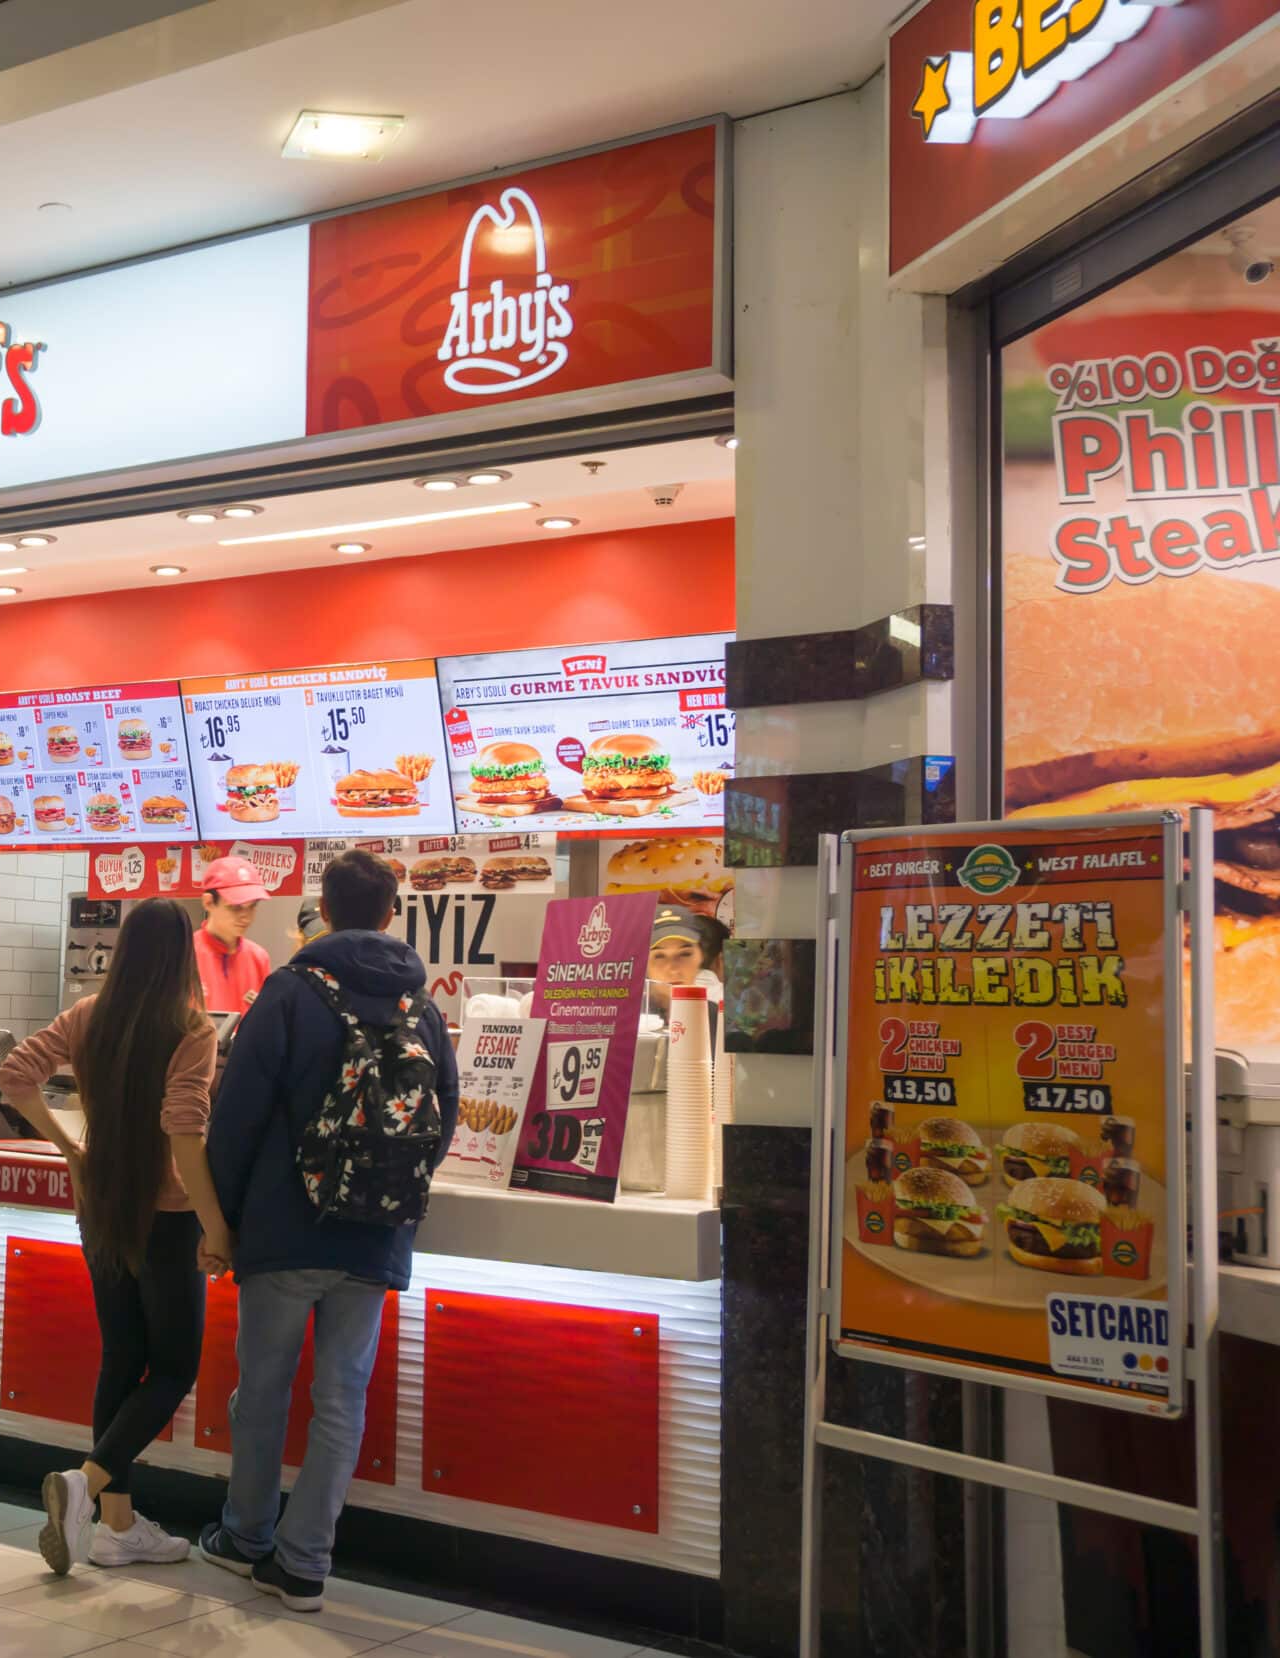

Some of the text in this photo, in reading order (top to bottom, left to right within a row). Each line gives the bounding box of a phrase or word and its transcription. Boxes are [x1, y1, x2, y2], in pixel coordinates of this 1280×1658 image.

[437, 272, 573, 362] Arby's
[1050, 355, 1181, 411] %100
[566, 657, 603, 673] YENİ
[270, 673, 327, 687] CHICKEN
[455, 685, 482, 700] ARBY'S
[510, 680, 575, 697] GURME
[578, 674, 640, 692] TAVUK
[56, 689, 122, 703] ROAST BEEF
[870, 860, 940, 878] BEST BURGER
[1038, 850, 1147, 873] WEST FALAFEL
[880, 901, 1116, 952] LEZZETİ
[547, 957, 634, 982] SİNEMA KEYFİ
[874, 954, 1128, 1008] İKİLEDİK
[550, 1002, 618, 1017] Cinemaximum
[481, 1024, 523, 1034] YANINDA
[908, 1021, 940, 1038] BEST
[1057, 1025, 1096, 1042] BEST
[475, 1035, 521, 1057] EFSANE
[879, 1017, 908, 1073] 2
[908, 1038, 962, 1057] CHICKEN
[1014, 1021, 1057, 1080] 2
[1057, 1042, 1116, 1061] BURGER
[473, 1056, 517, 1070] OLSUN
[908, 1055, 945, 1073] MENÜ
[1057, 1061, 1102, 1080] MENÜ
[527, 1111, 582, 1162] 3D
[1049, 1298, 1169, 1347] SETCARD
